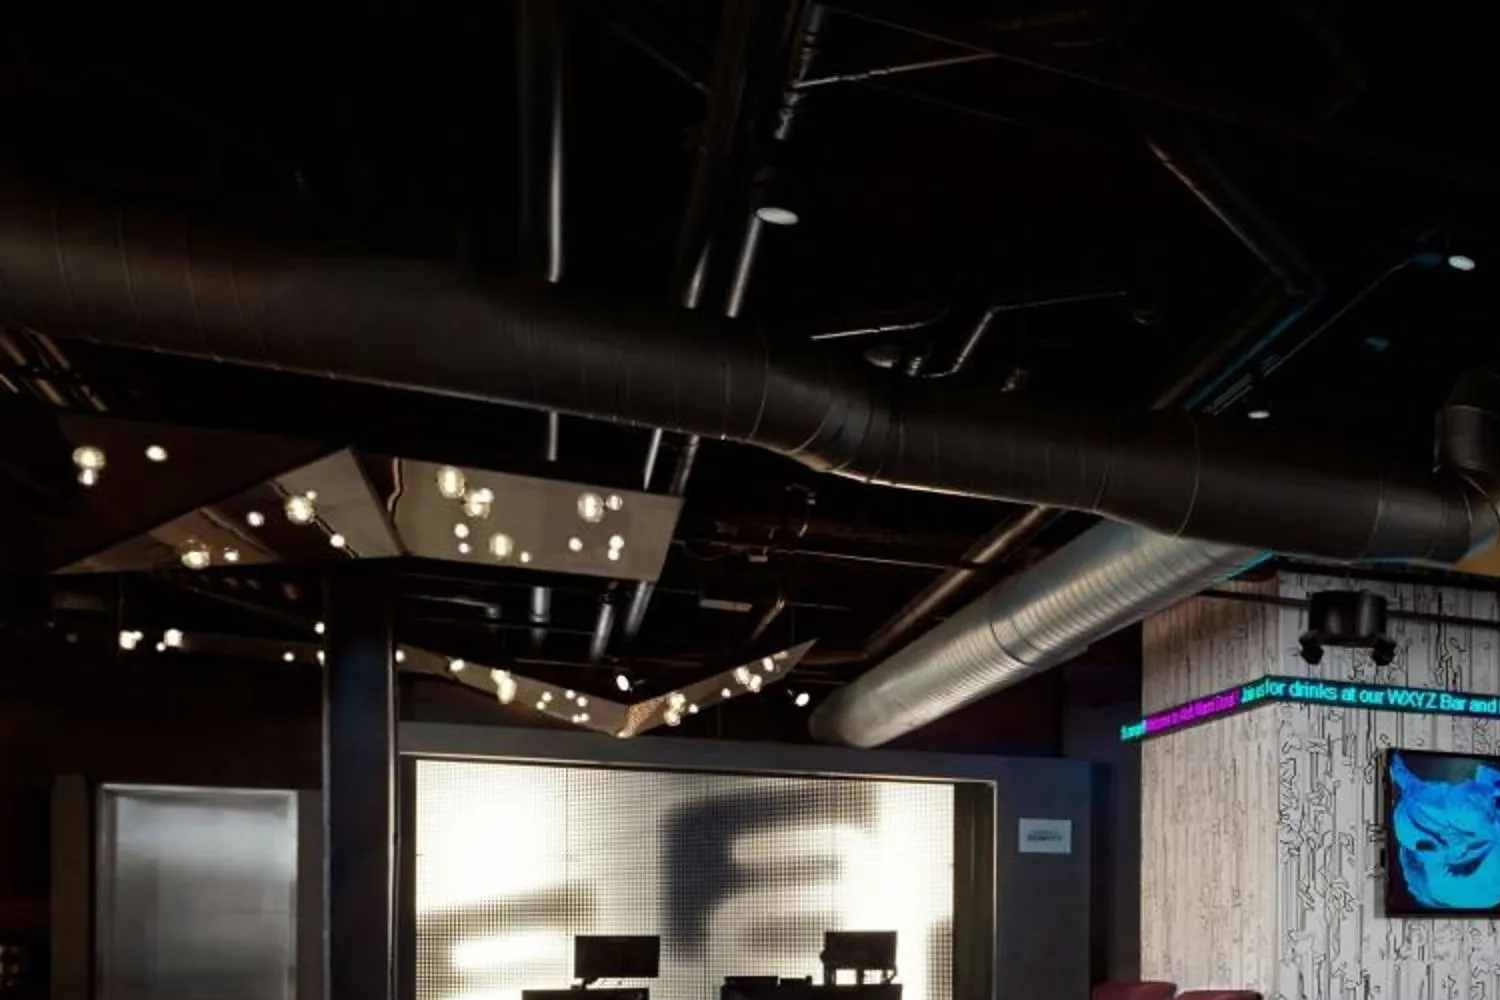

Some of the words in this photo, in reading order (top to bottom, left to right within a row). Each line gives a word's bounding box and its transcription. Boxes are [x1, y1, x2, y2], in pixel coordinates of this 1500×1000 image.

[1265, 677, 1285, 696] for
[1289, 680, 1337, 700] drinks
[1342, 687, 1356, 701] at
[1359, 691, 1384, 705] our
[1387, 688, 1438, 709] WXYZ
[1440, 693, 1467, 711] Bar
[1469, 698, 1497, 714] and
